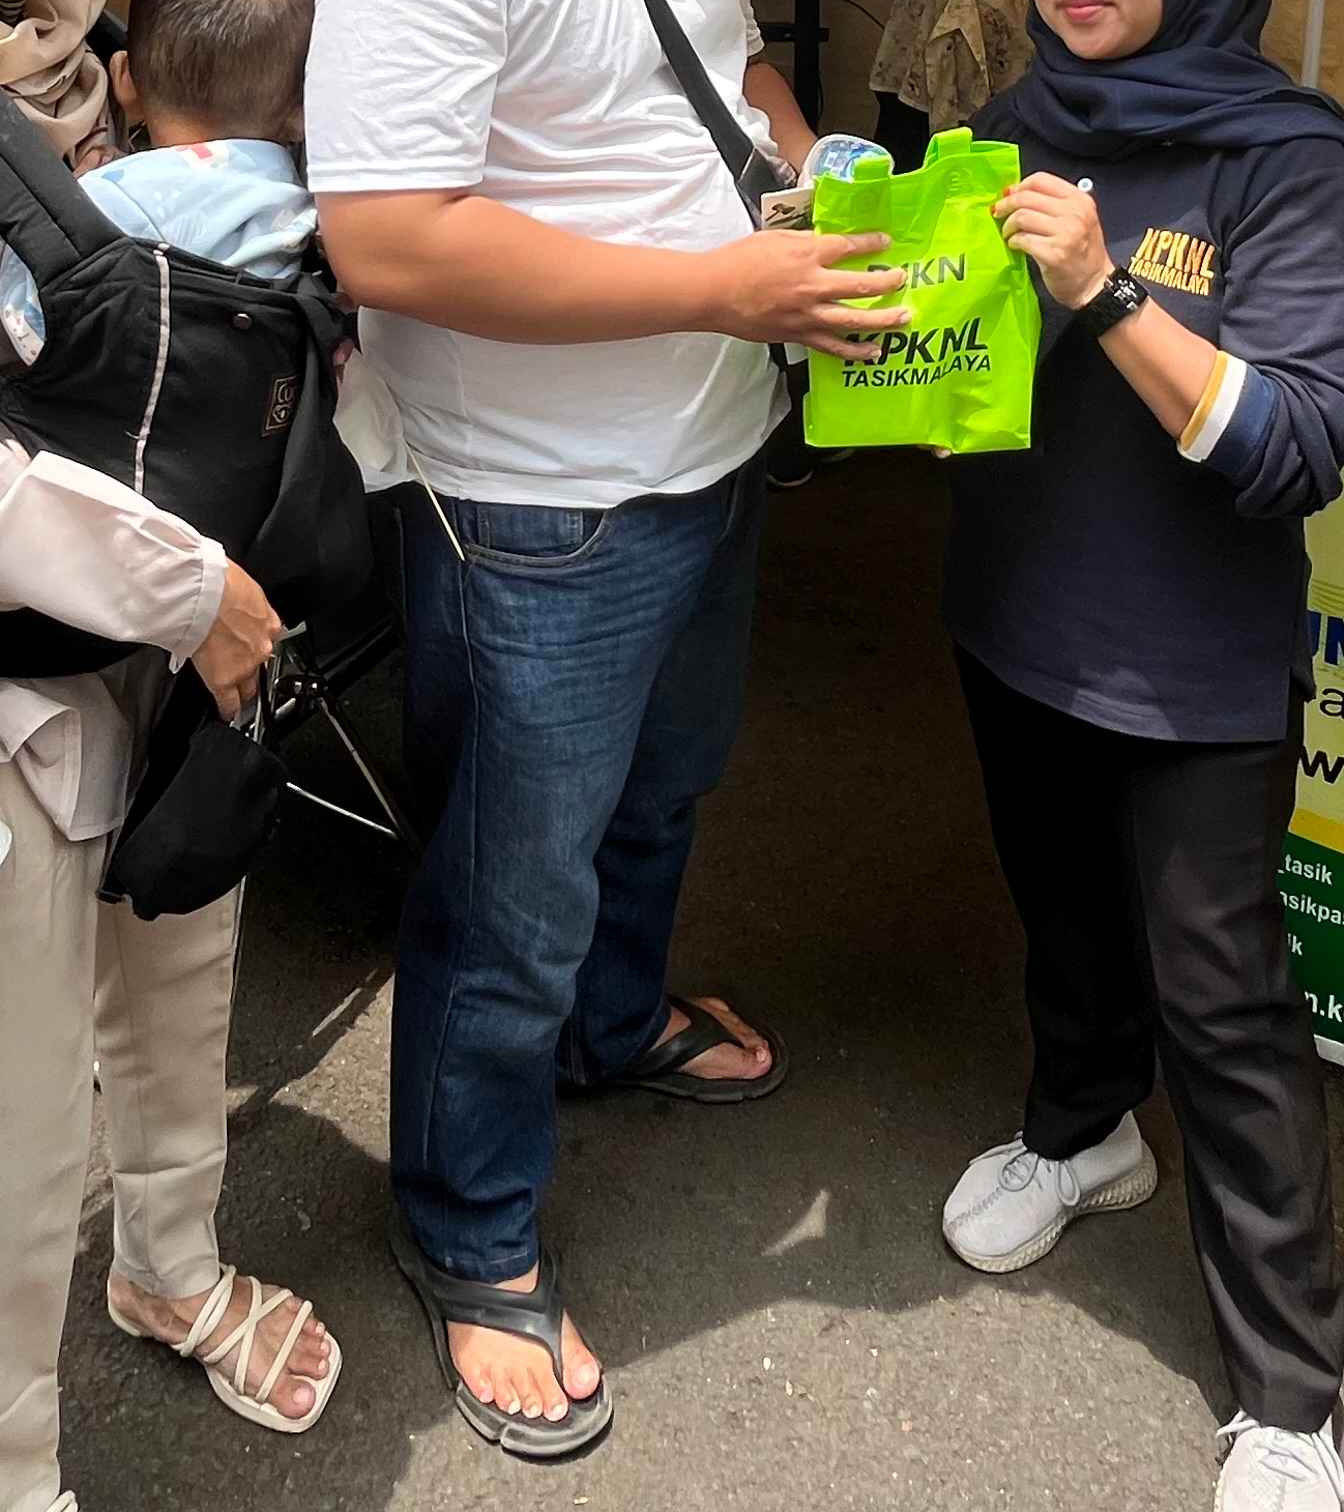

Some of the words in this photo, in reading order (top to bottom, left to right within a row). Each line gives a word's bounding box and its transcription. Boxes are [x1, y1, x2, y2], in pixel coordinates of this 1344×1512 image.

[867, 252, 966, 292] KN
[1134, 227, 1216, 279] KPKNL
[1127, 256, 1211, 296] TASIKMALAYA
[844, 317, 988, 367] KPKNL
[842, 354, 991, 388] TASIKMALAYA
